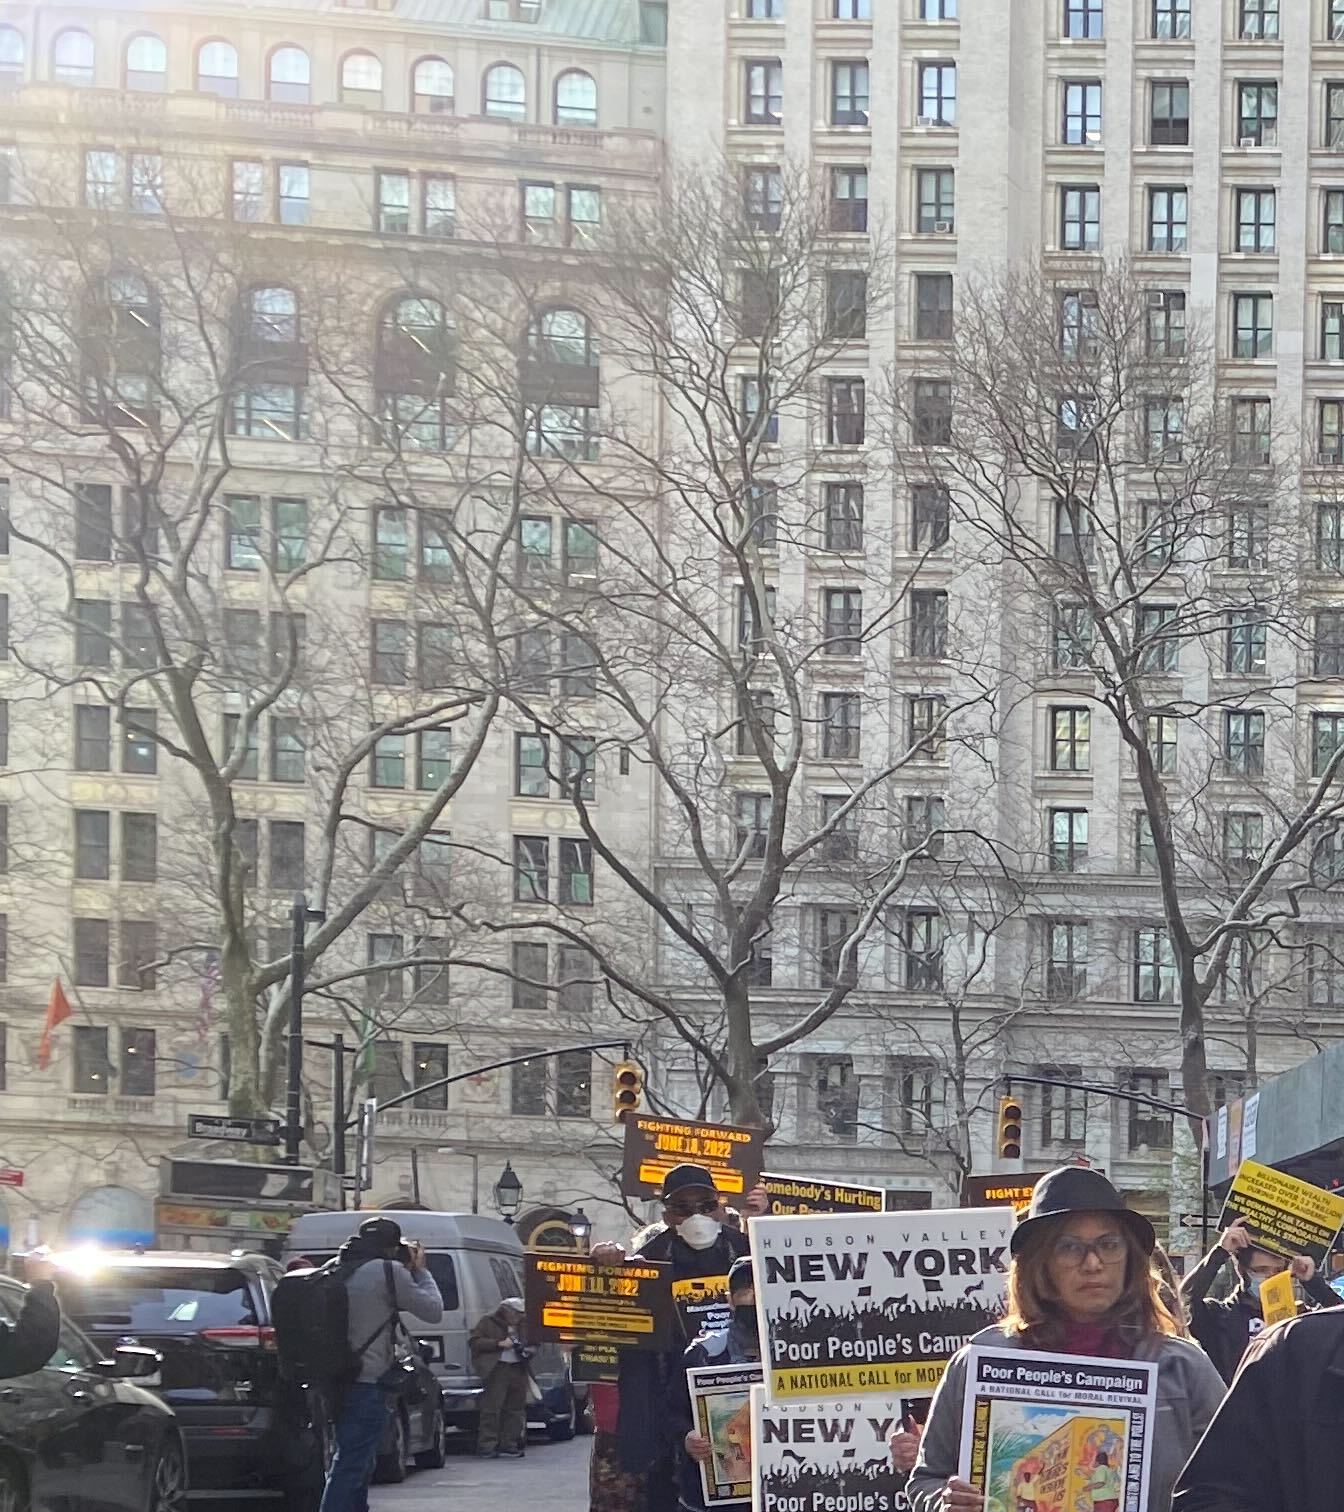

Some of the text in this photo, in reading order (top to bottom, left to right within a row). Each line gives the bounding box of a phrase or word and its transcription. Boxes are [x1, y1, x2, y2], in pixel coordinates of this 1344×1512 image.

[766, 1182, 832, 1202] omebody's
[834, 1188, 882, 1211] Hurting
[985, 1187, 1020, 1200] FIGHT
[763, 1228, 1007, 1249] HUDSON VALLEY
[765, 1246, 1009, 1285] NEW YORK
[773, 1334, 913, 1363] Poor People's
[777, 1369, 912, 1390] A NATIONAL CALL for
[982, 1364, 1143, 1391] Poor People's Campaign
[989, 1386, 1031, 1396] NATIONAL
[1033, 1388, 1055, 1398] CALL
[1074, 1392, 1105, 1402] MORAL
[763, 1418, 855, 1444] NEW
[764, 1492, 806, 1512] Poor
